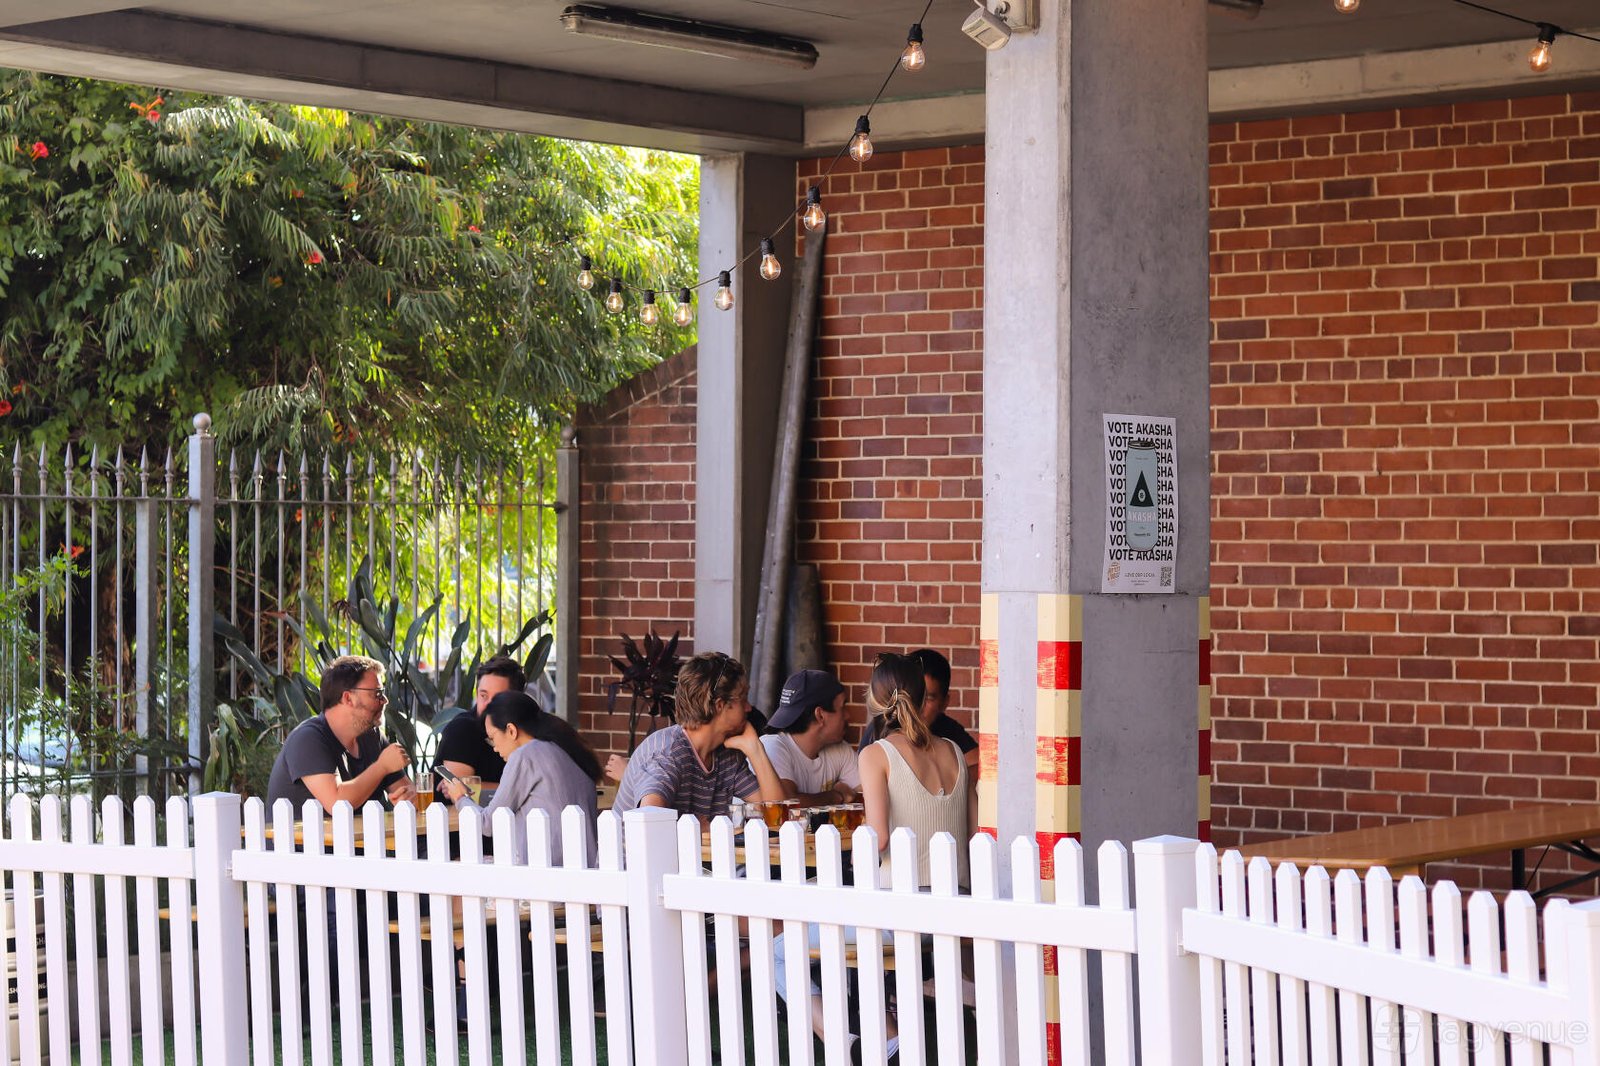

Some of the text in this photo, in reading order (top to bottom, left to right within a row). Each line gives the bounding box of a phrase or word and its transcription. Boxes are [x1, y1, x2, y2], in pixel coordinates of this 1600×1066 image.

[1107, 421, 1173, 436] VOTE AKASHA
[1109, 450, 1173, 464] VOT SHA
[1127, 510, 1157, 523] AKASHA
[1110, 534, 1128, 546] VOT
[1156, 536, 1174, 547] SHA
[1109, 549, 1173, 561] VOTE AKASHA
